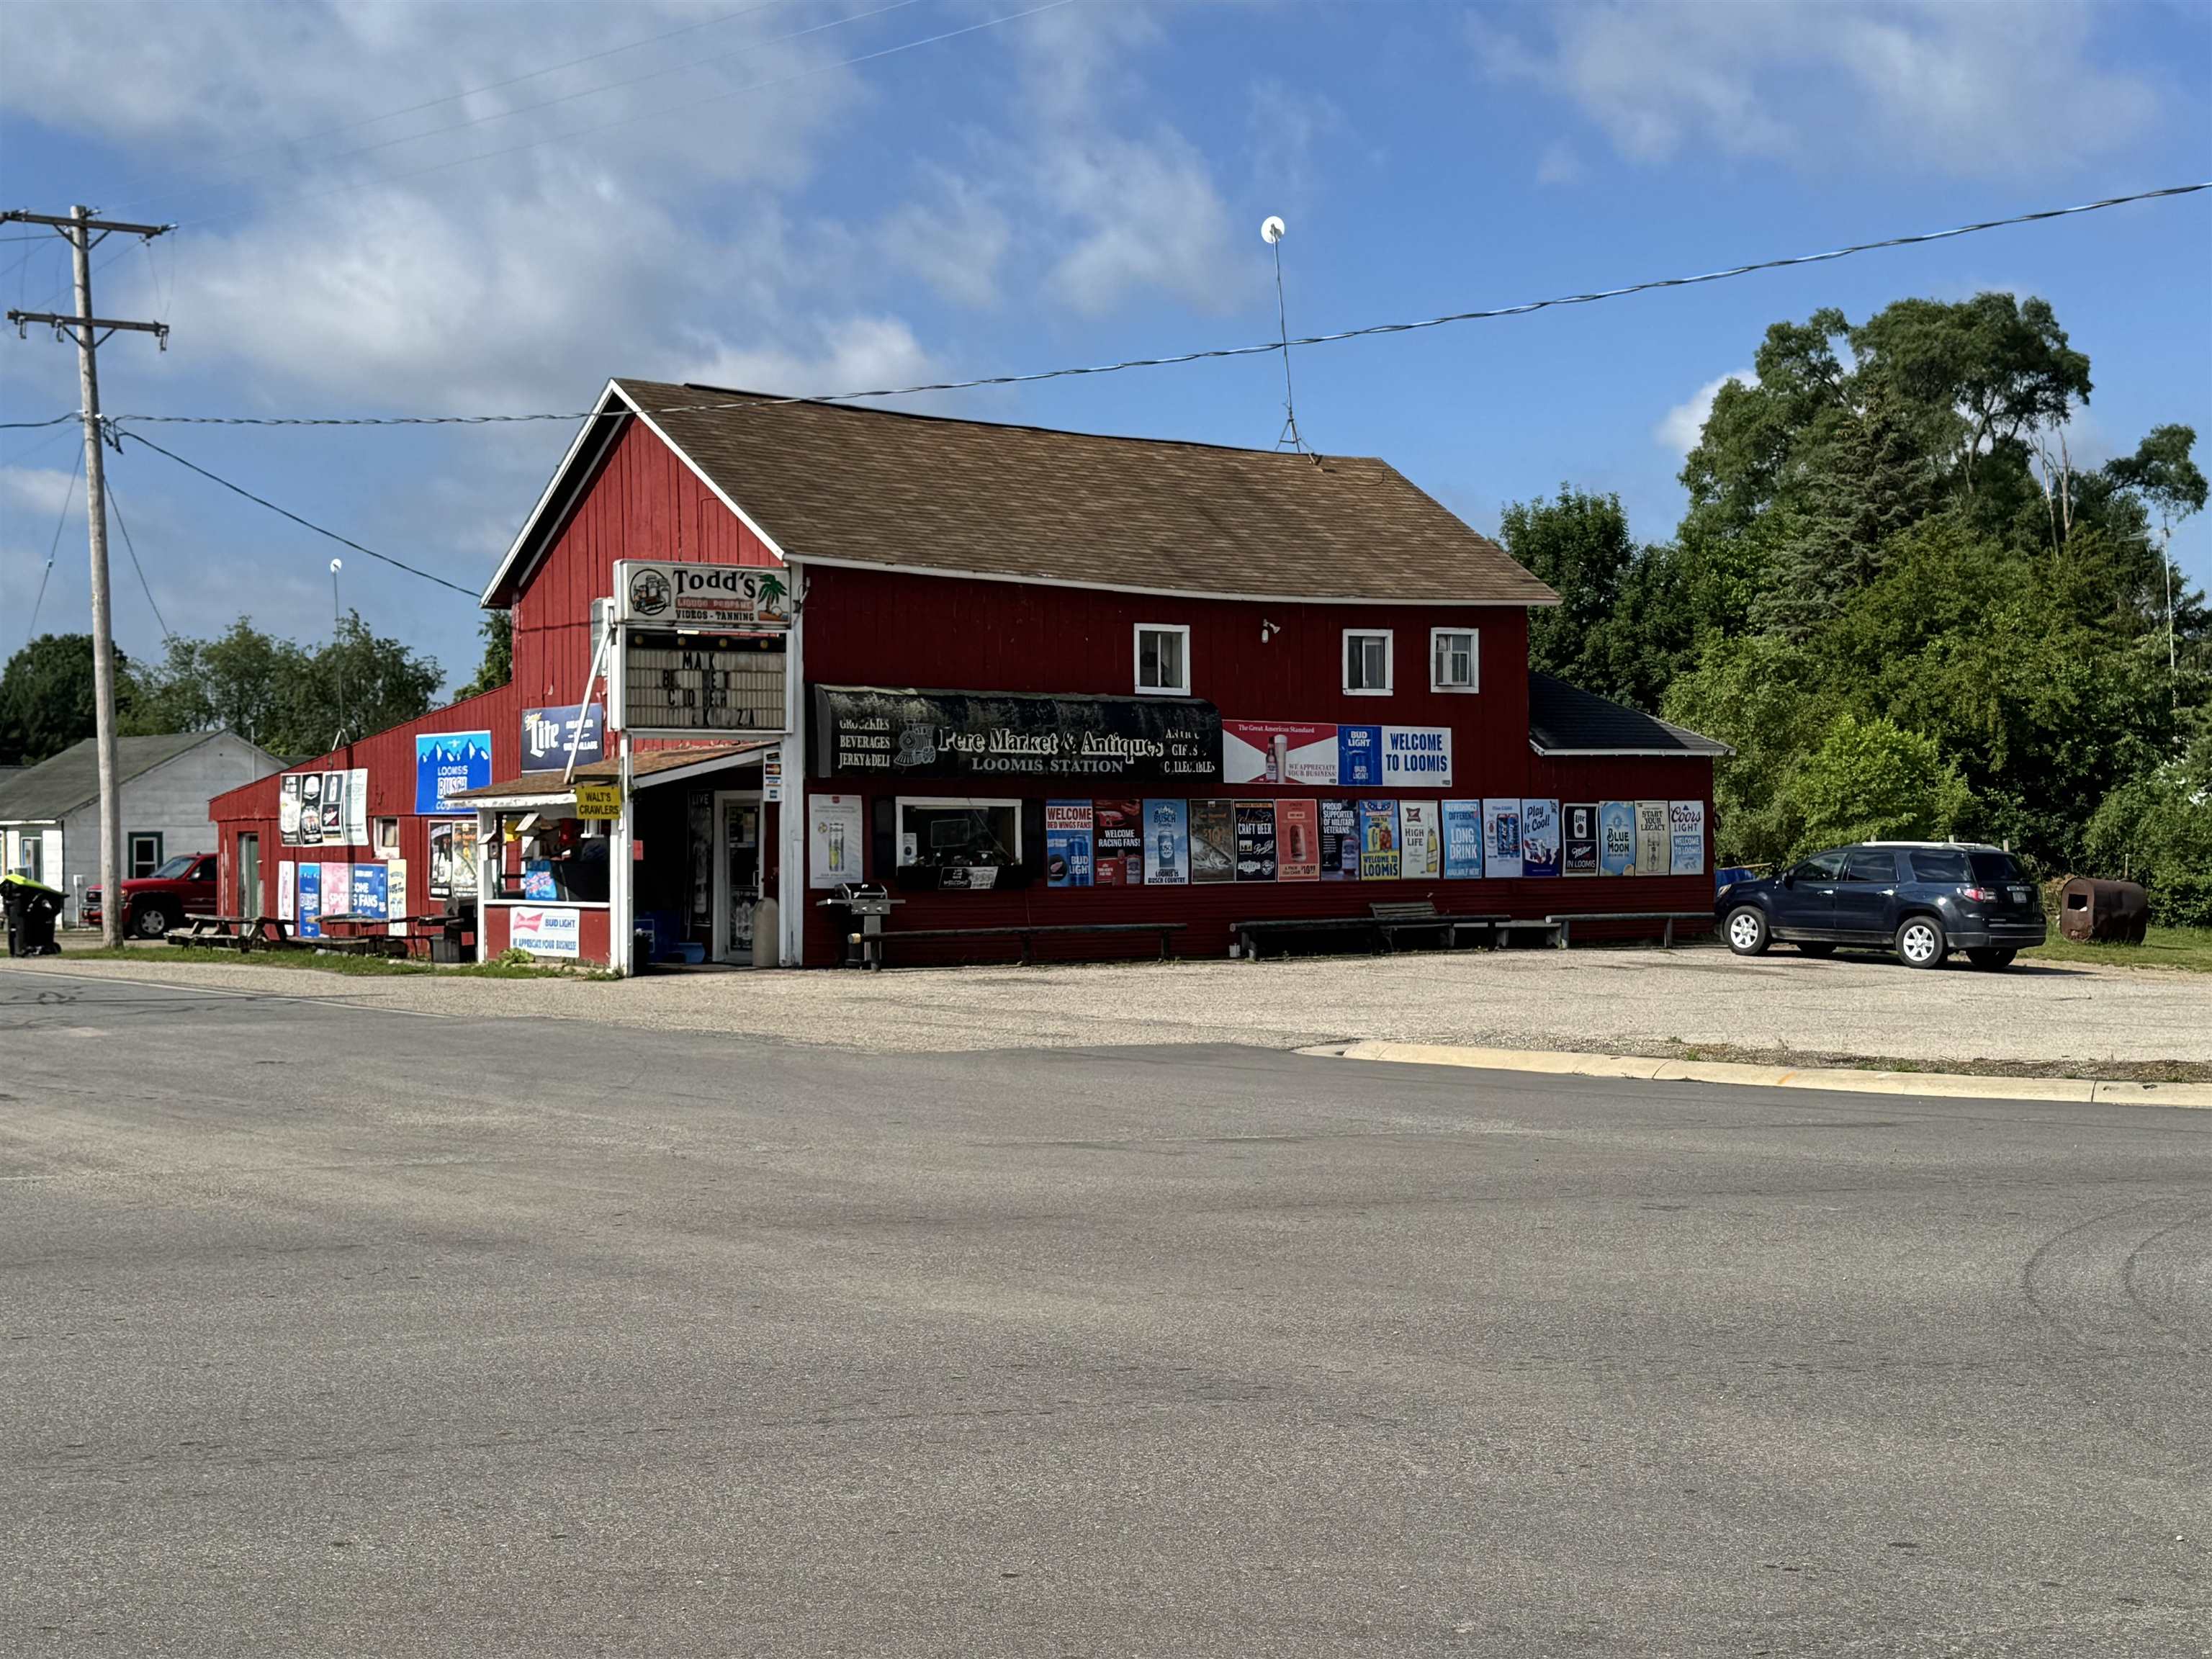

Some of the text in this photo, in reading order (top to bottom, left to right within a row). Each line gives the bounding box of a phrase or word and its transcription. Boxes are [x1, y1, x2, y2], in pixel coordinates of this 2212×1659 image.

[673, 570, 755, 598] Todd's
[675, 610, 708, 619] VIDEOS
[715, 611, 754, 621] TANNING
[530, 720, 559, 757] Lite
[840, 734, 891, 749] BEVERAGES
[1348, 739, 1371, 747] LIGHT
[1390, 733, 1443, 751] WELCOME
[989, 728, 1058, 755] Market
[1081, 731, 1164, 764] Antiques
[1172, 744, 1197, 756] GIFS
[837, 752, 865, 769] JERKY
[871, 754, 890, 767] DELI
[971, 757, 1123, 773] LOOMIS STATION
[1386, 754, 1447, 772] TO LOOMIS
[585, 791, 611, 802] WALT'S
[579, 804, 619, 815] CRAWLERS
[1048, 808, 1092, 820] WELCOME
[1527, 806, 1544, 819] Play
[1671, 806, 1701, 822] Coors
[1154, 814, 1176, 823] BUSCH
[1532, 814, 1550, 831] Cool!
[1105, 830, 1135, 838] WELCOME
[1238, 824, 1272, 835] CRAFT BEER
[1323, 826, 1350, 835] VETERANS
[1450, 828, 1475, 843] LONG
[1607, 828, 1629, 842] BLUE
[1098, 838, 1123, 848] RACING
[1607, 842, 1629, 853] MOON
[1449, 844, 1478, 859] DRINK
[1071, 855, 1089, 864] BUD
[1363, 855, 1389, 864] WELCOME
[1575, 860, 1596, 868] LOOMIS
[1364, 865, 1398, 876] LOOMIS
[359, 894, 378, 908] FANS
[544, 918, 558, 927] BUD
[559, 919, 576, 928] LIGHT
